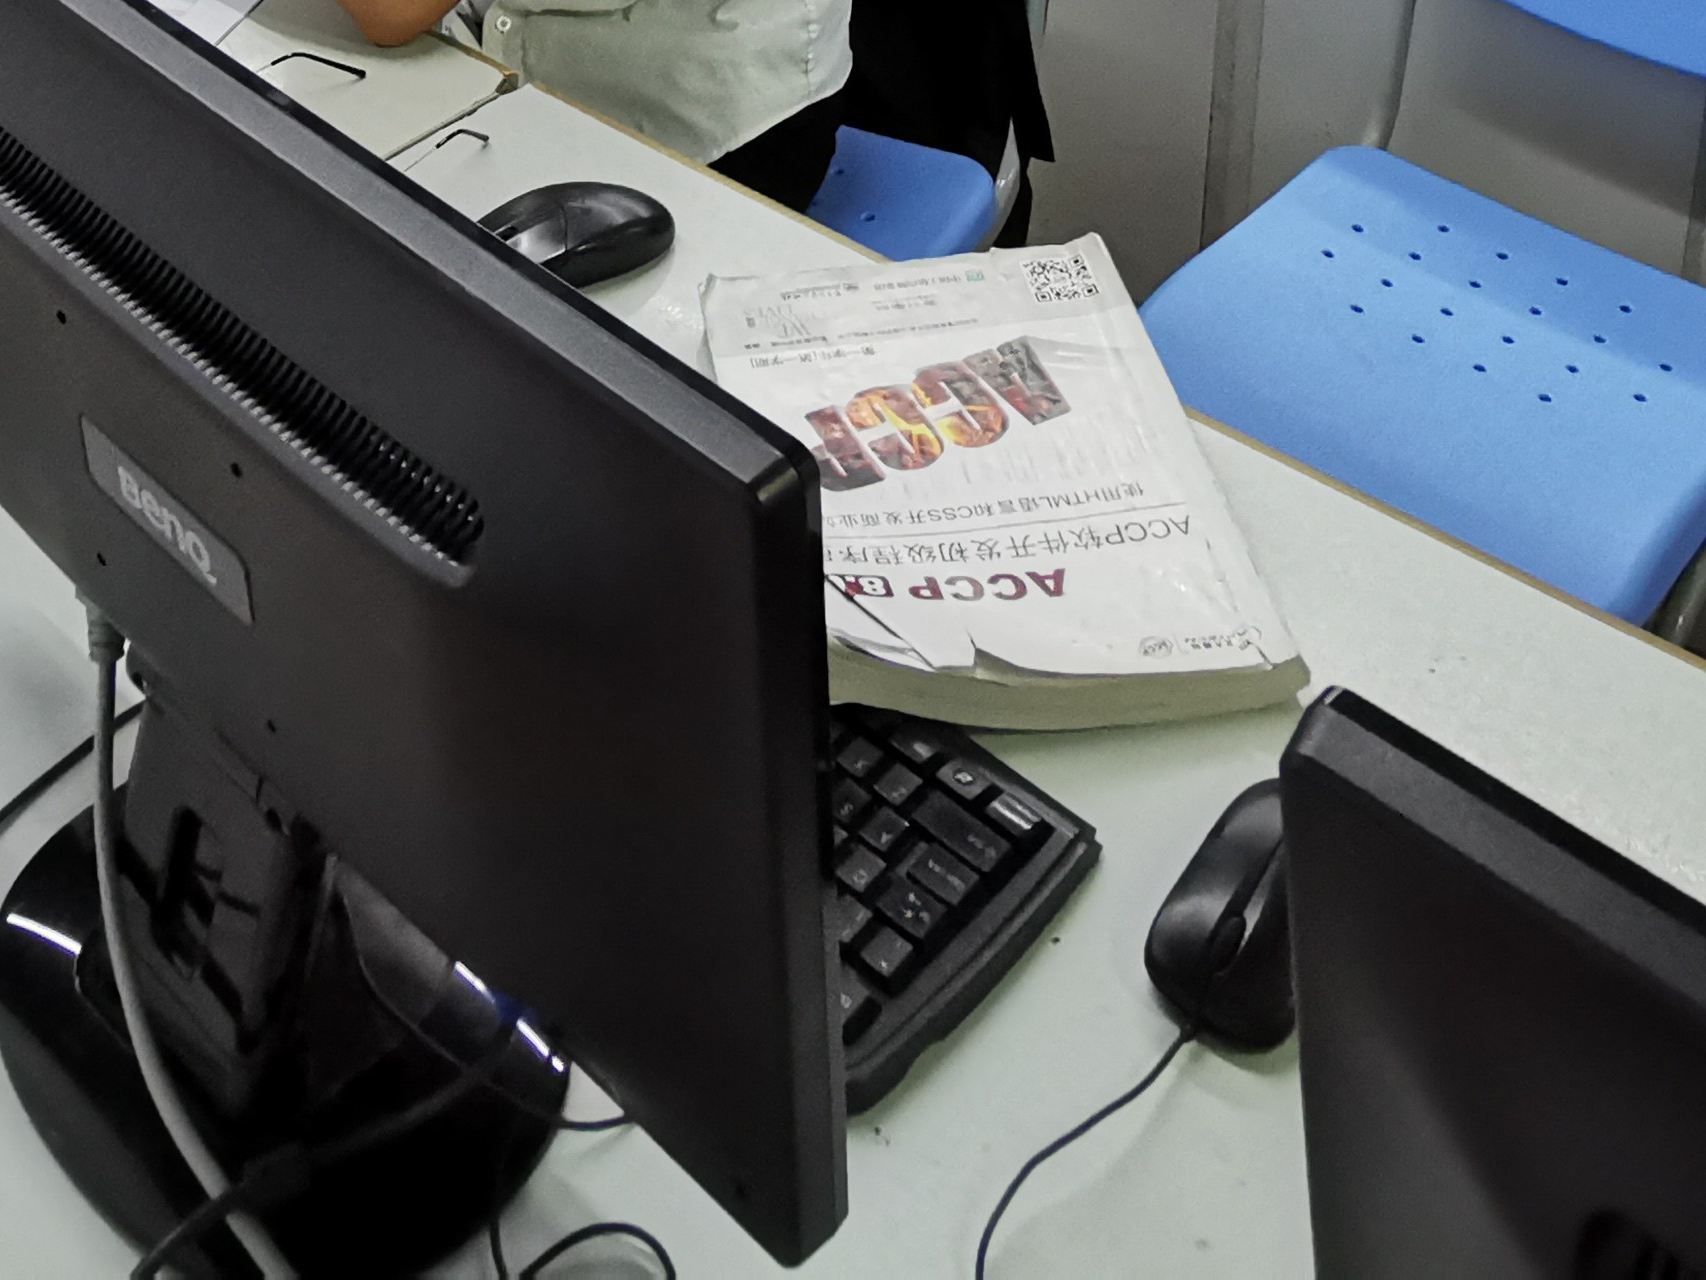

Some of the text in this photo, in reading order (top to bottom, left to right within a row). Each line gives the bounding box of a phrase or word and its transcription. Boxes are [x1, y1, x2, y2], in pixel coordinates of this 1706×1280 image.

[117, 465, 218, 587] BenQ
[824, 515, 1192, 568] ACCP软件开发初级程序
[907, 568, 1068, 602] ACCP
